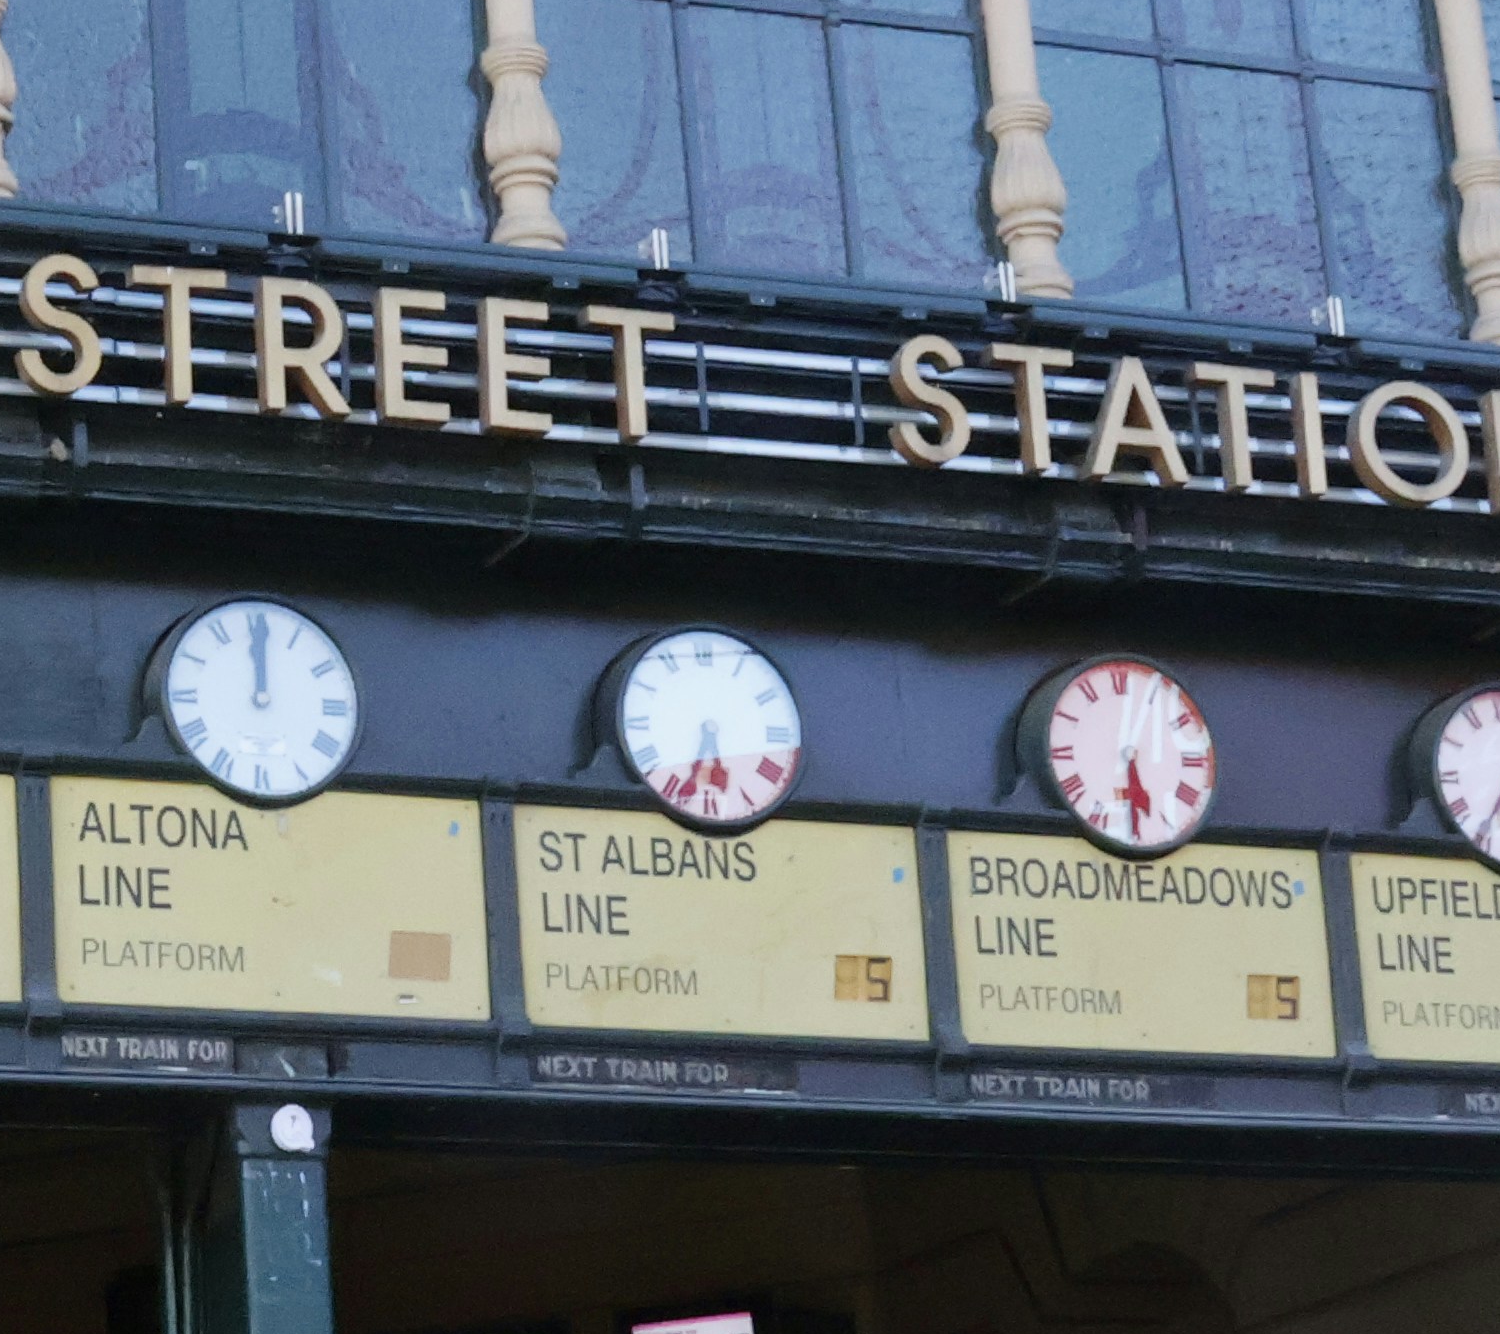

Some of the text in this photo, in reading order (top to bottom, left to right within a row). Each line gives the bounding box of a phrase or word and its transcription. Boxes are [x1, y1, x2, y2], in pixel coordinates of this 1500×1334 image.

[15, 253, 675, 445] STREET
[78, 802, 249, 851] ALTONA
[539, 830, 757, 882] ST ALBANS
[78, 864, 173, 910] LINE
[969, 856, 1293, 909] BROADMEADOWS
[541, 891, 630, 937] LINE
[974, 915, 1058, 958] LINE
[81, 937, 246, 973] PLATFORM
[1377, 932, 1455, 974] LINE
[545, 957, 890, 1004] PLATFORM 5
[979, 976, 1299, 1022] PLATFORM 5
[61, 1034, 228, 1062] NEXT TRAIN FOR
[536, 1053, 729, 1083] NEXT TRAIN FOR
[969, 1073, 1150, 1102] NEXT TRAIN FOR
